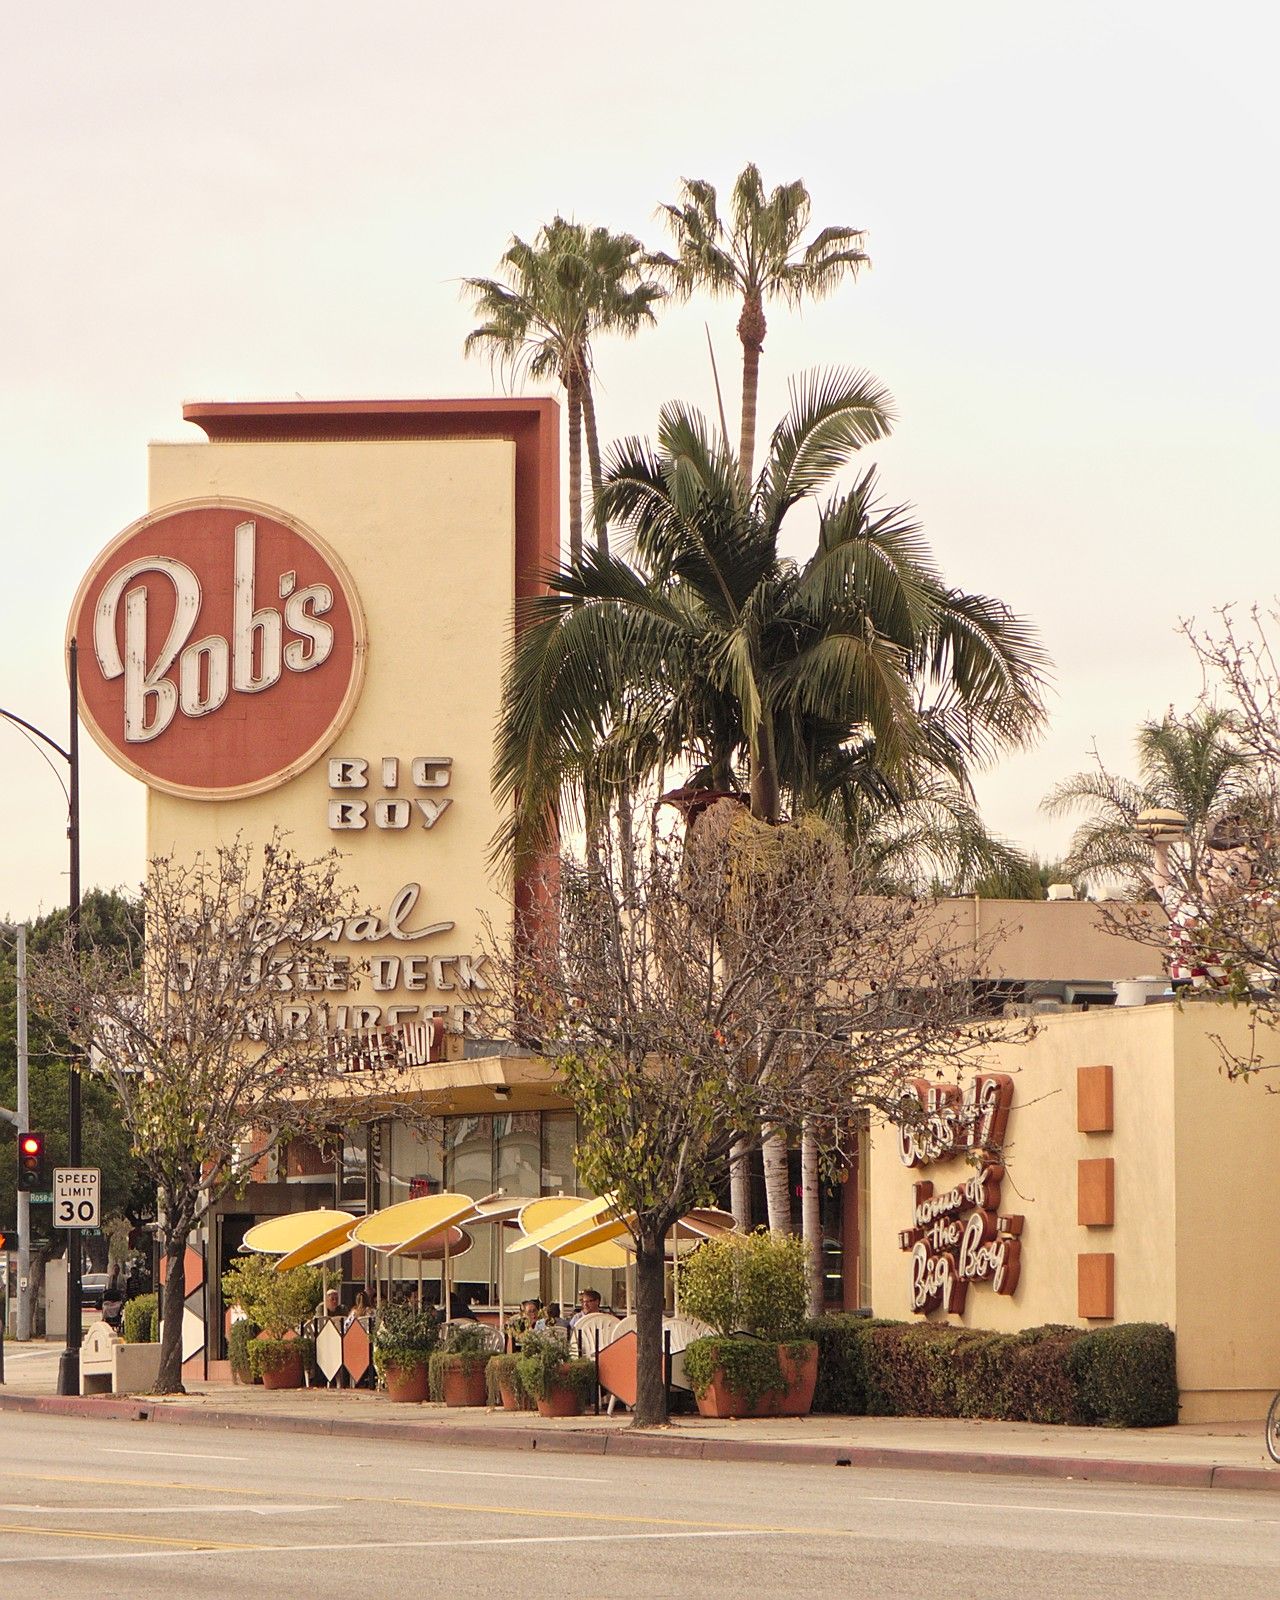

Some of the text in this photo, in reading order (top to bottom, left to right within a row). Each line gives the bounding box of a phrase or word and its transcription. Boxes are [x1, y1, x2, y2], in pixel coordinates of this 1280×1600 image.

[93, 520, 334, 743] Bob's
[328, 757, 453, 789] BIG
[328, 798, 453, 830] BOY
[371, 955, 493, 992] DECK
[57, 1174, 97, 1184] SPEED
[61, 1187, 93, 1197] LIMIT
[30, 1193, 48, 1202] Rose
[59, 1200, 95, 1221] 30
[912, 1163, 989, 1228] home of
[926, 1219, 960, 1253] the
